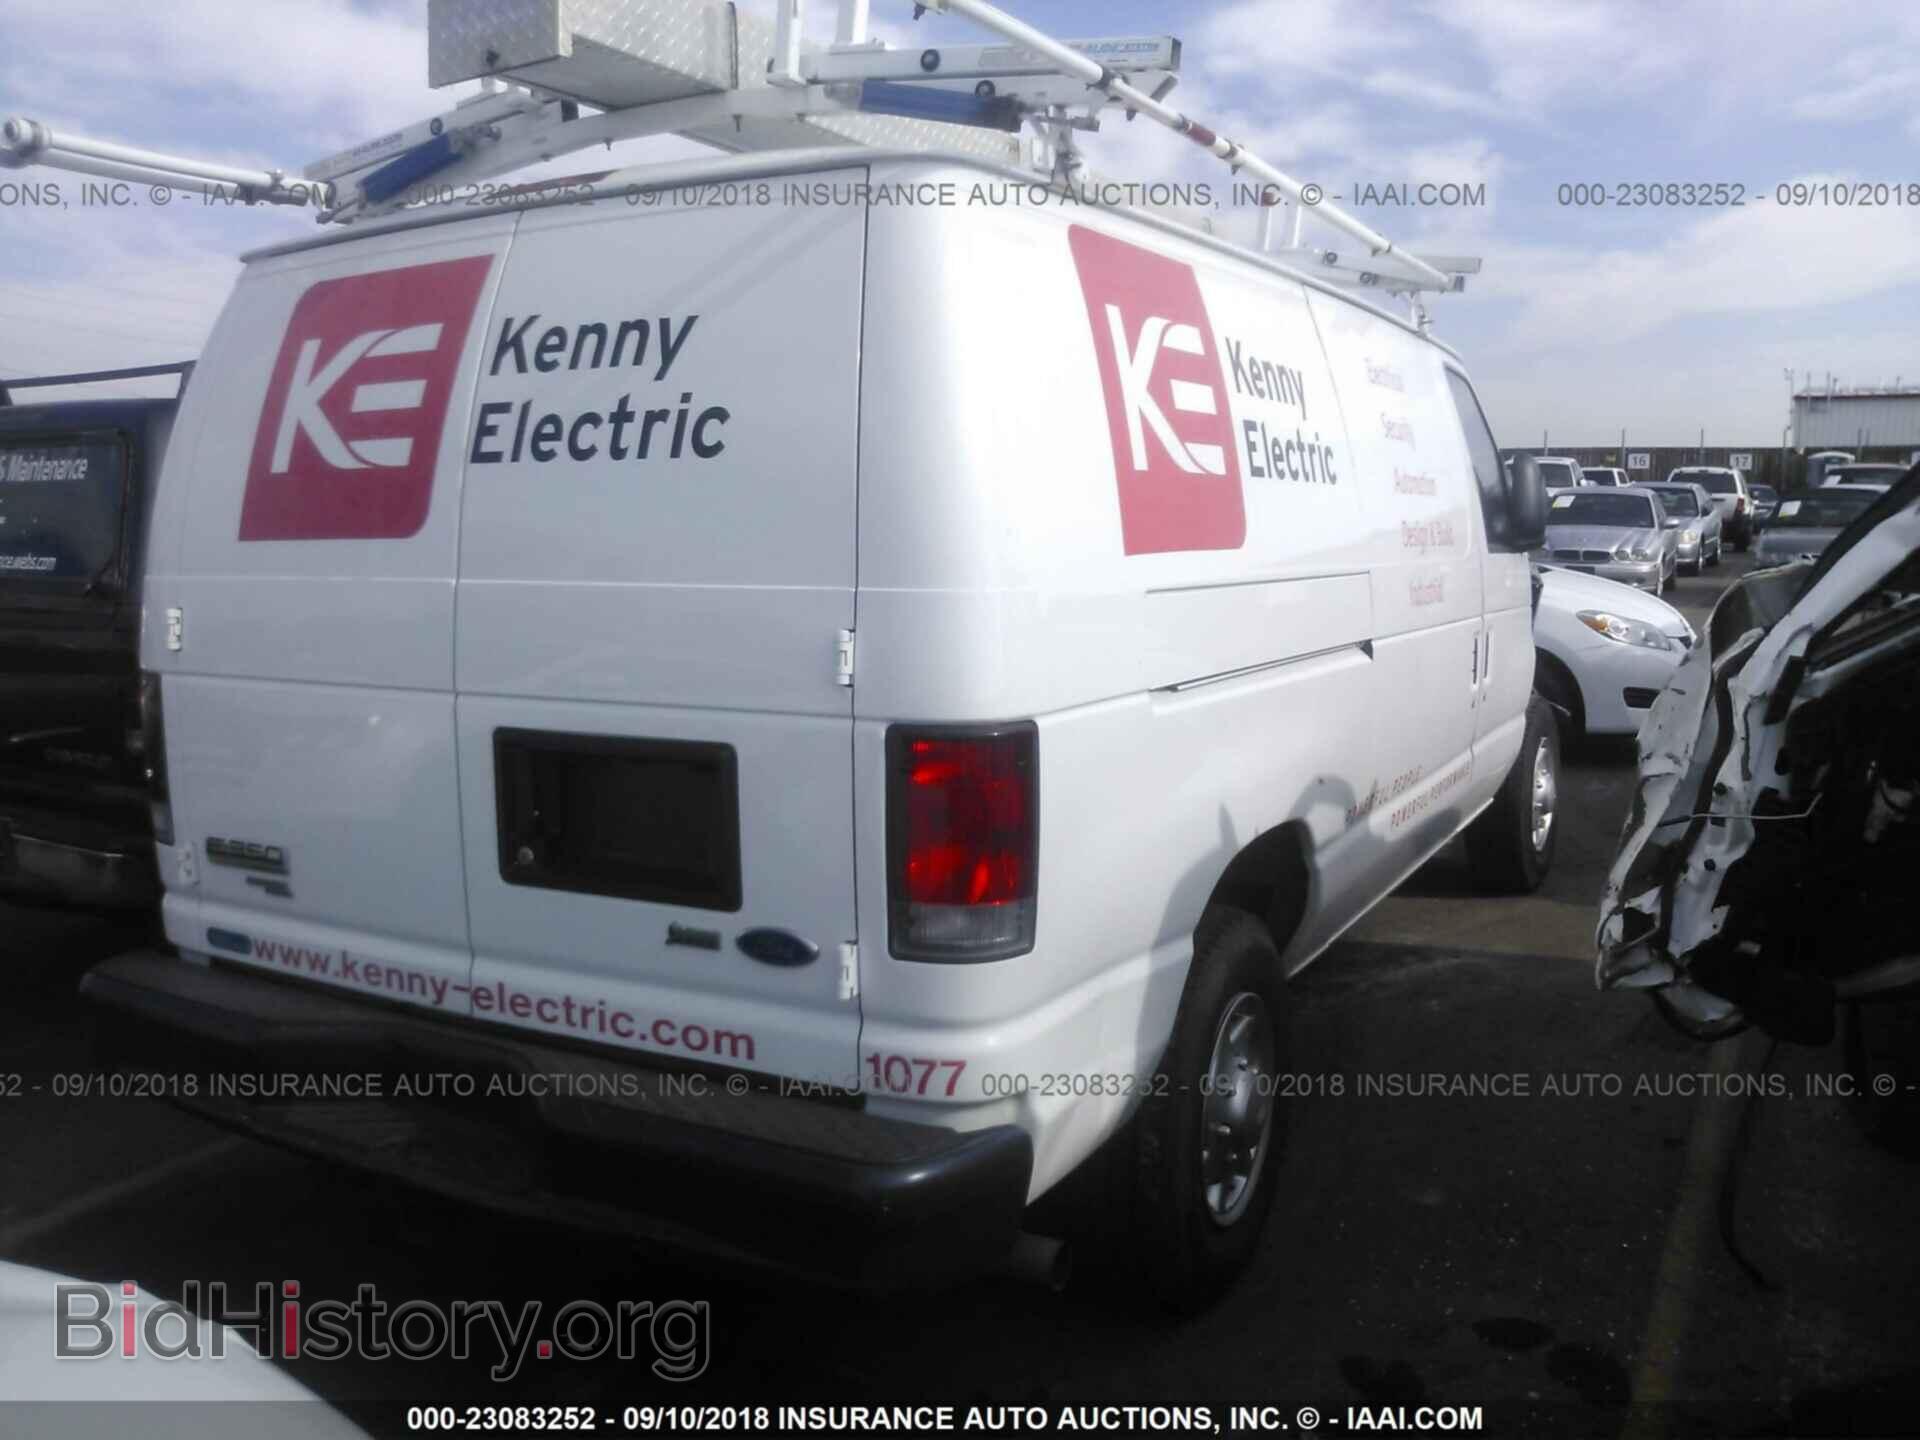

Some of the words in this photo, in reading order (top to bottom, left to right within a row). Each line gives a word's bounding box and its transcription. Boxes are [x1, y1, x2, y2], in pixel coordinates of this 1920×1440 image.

[489, 314, 699, 381] Kenny
[1225, 336, 1306, 420] Kenny
[470, 392, 732, 464] Electric
[1242, 418, 1337, 486] Electric
[1631, 455, 1647, 467] 16
[1734, 456, 1749, 467] 17
[253, 938, 756, 1060] www.kenny-electric.com
[865, 1053, 966, 1097] 1077
